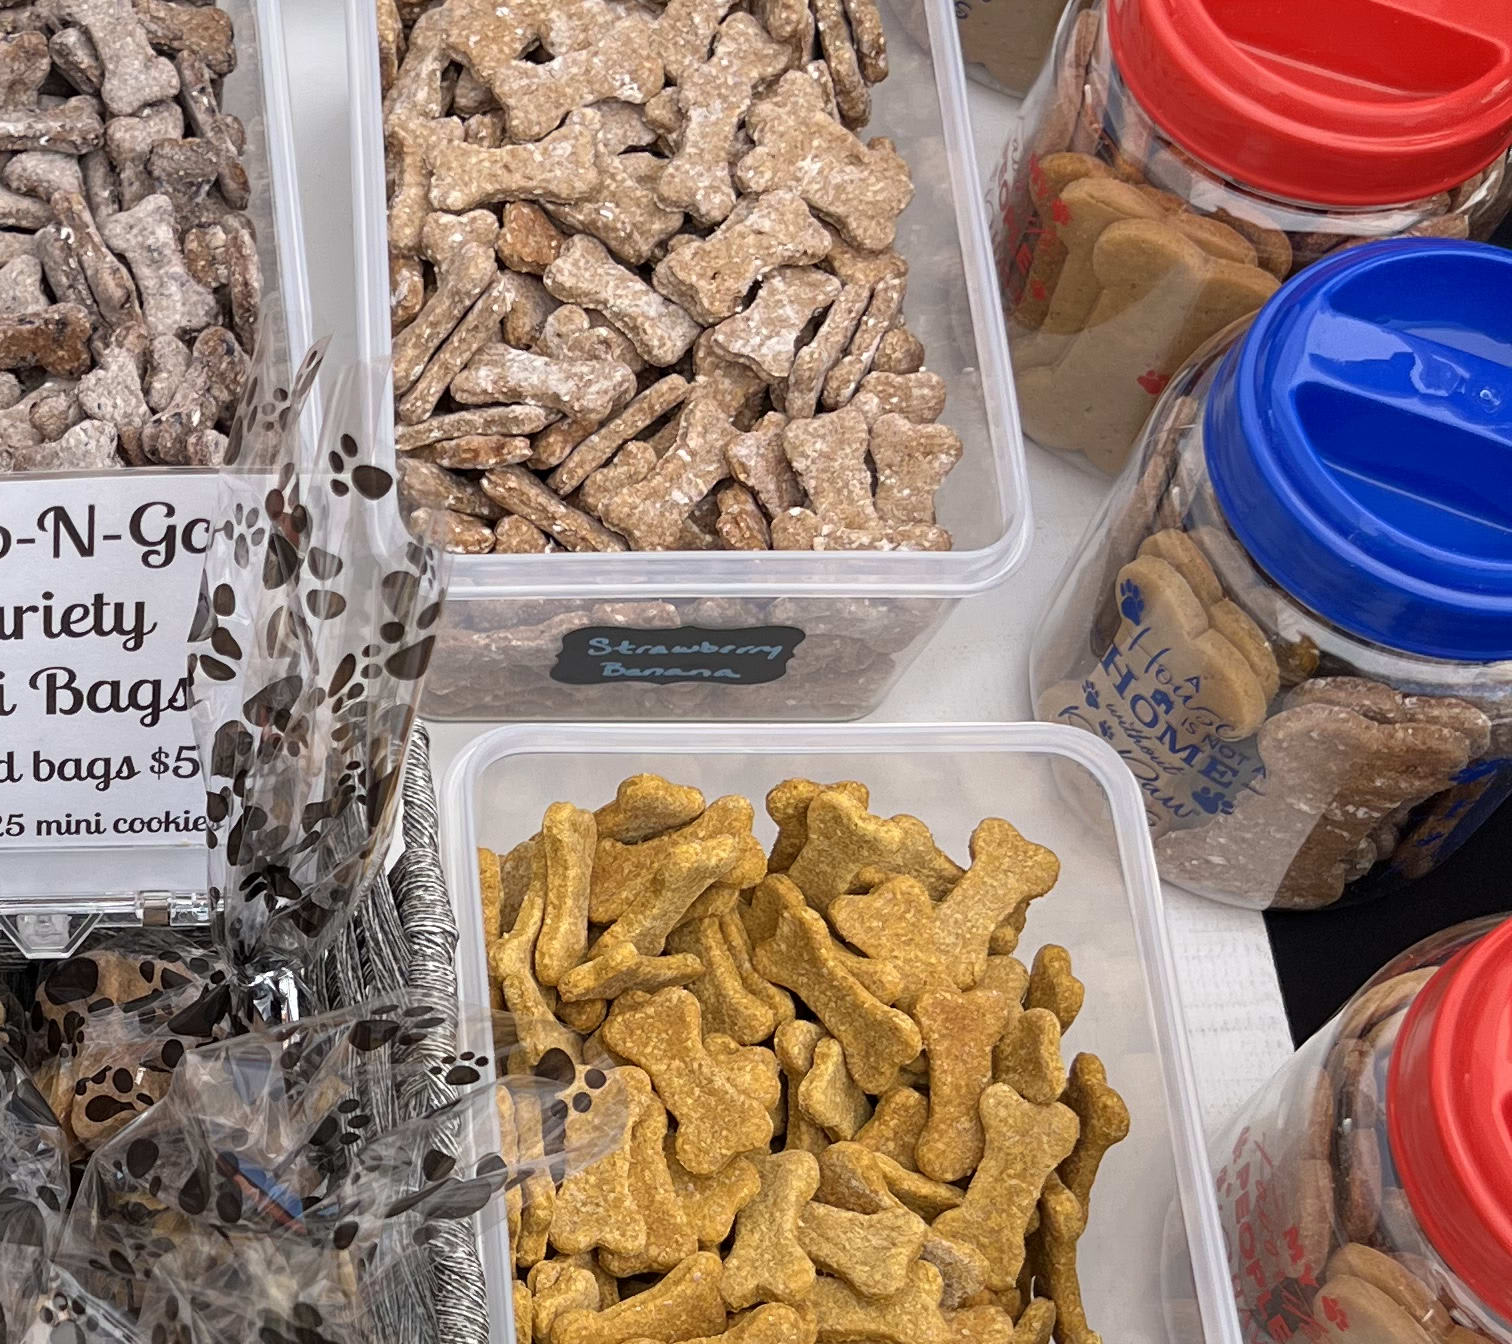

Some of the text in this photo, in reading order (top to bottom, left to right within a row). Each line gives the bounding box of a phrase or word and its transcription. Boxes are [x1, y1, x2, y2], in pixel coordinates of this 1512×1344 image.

[588, 638, 784, 660] Strawberry
[600, 662, 741, 678] Banana
[29, 666, 202, 728] Bags
[1100, 643, 1238, 790] HOME
[1202, 734, 1250, 765] NOT
[32, 750, 141, 792] bags
[36, 812, 105, 838] mini
